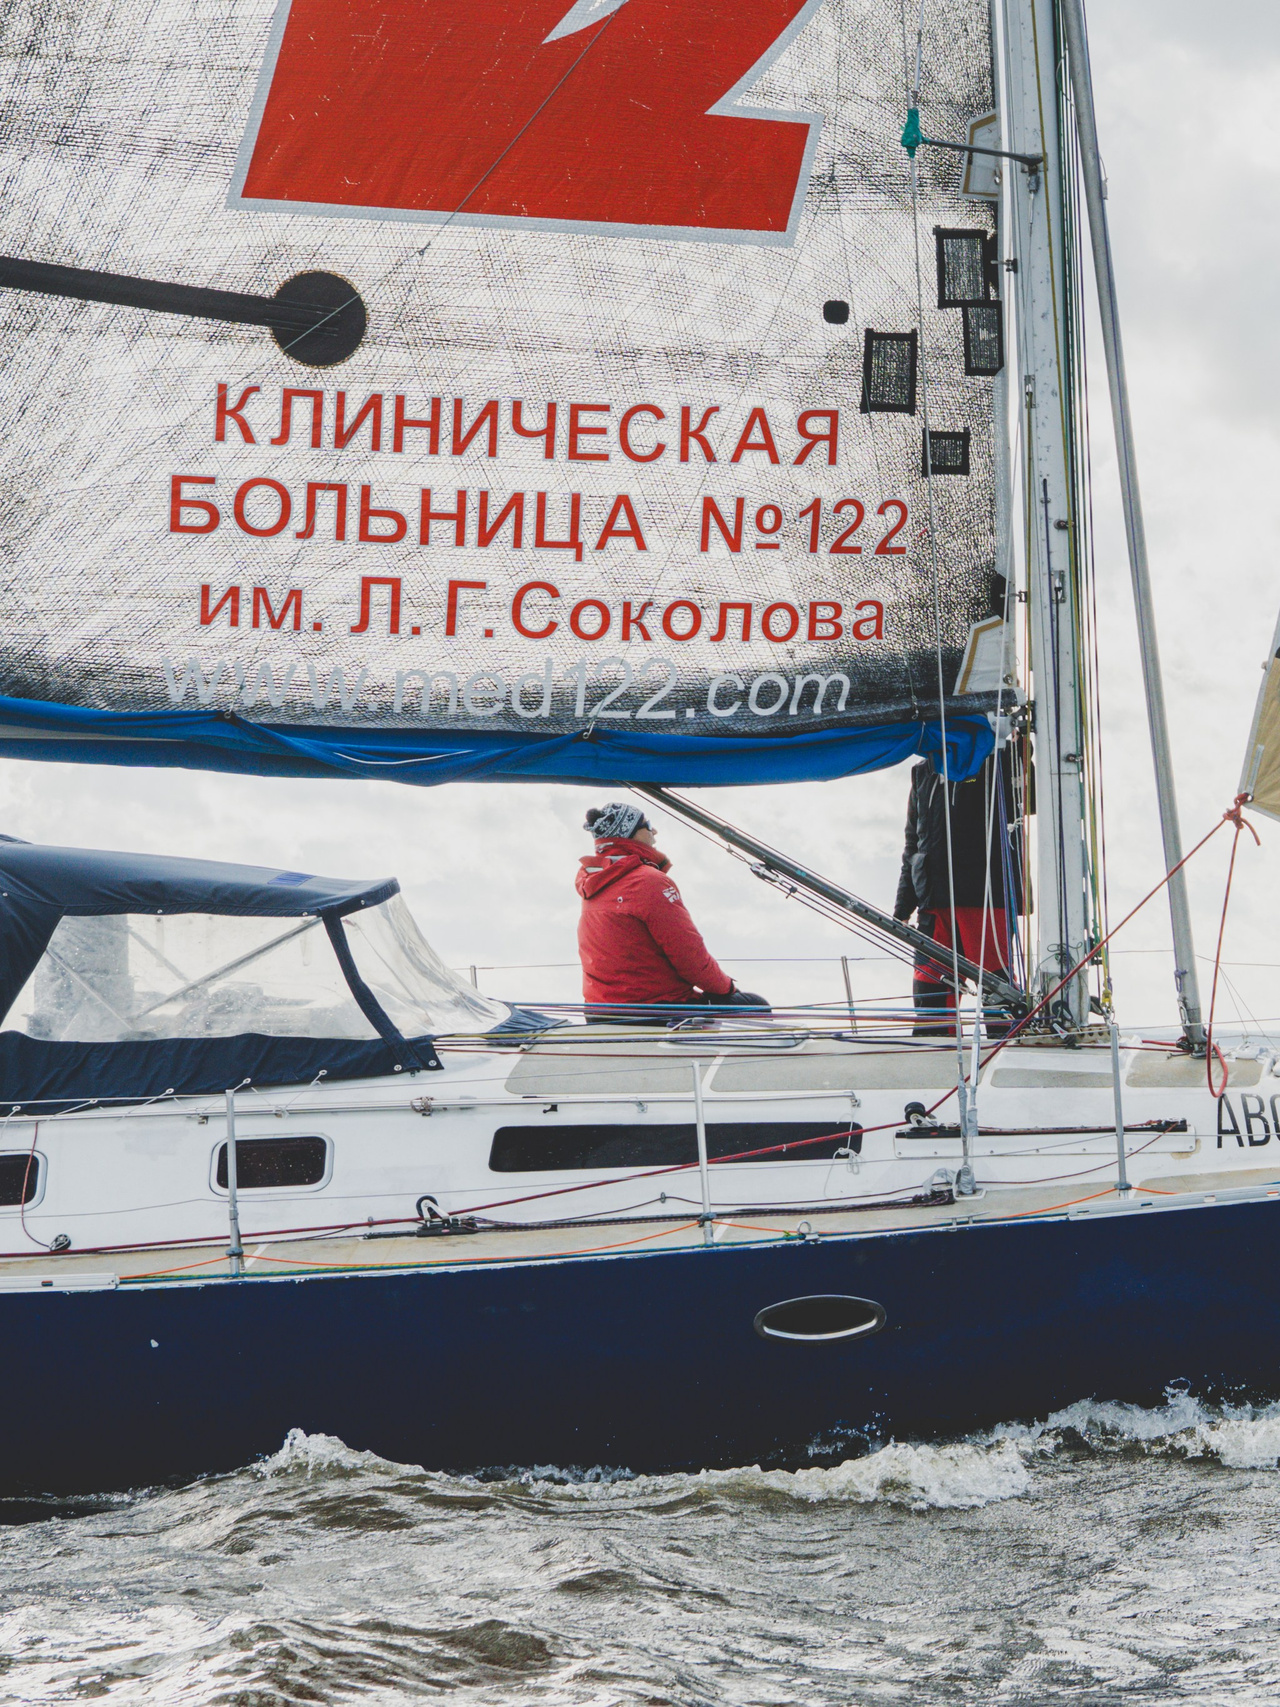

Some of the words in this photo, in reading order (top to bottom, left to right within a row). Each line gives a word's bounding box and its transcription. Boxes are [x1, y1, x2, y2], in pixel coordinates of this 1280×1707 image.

[214, 383, 841, 467] КЛИНИЧЕСКАЯ
[168, 474, 648, 562] БОЛЬНИЦА
[699, 496, 909, 556] №122
[199, 584, 323, 632] им.
[162, 656, 850, 719] www.med122.com
